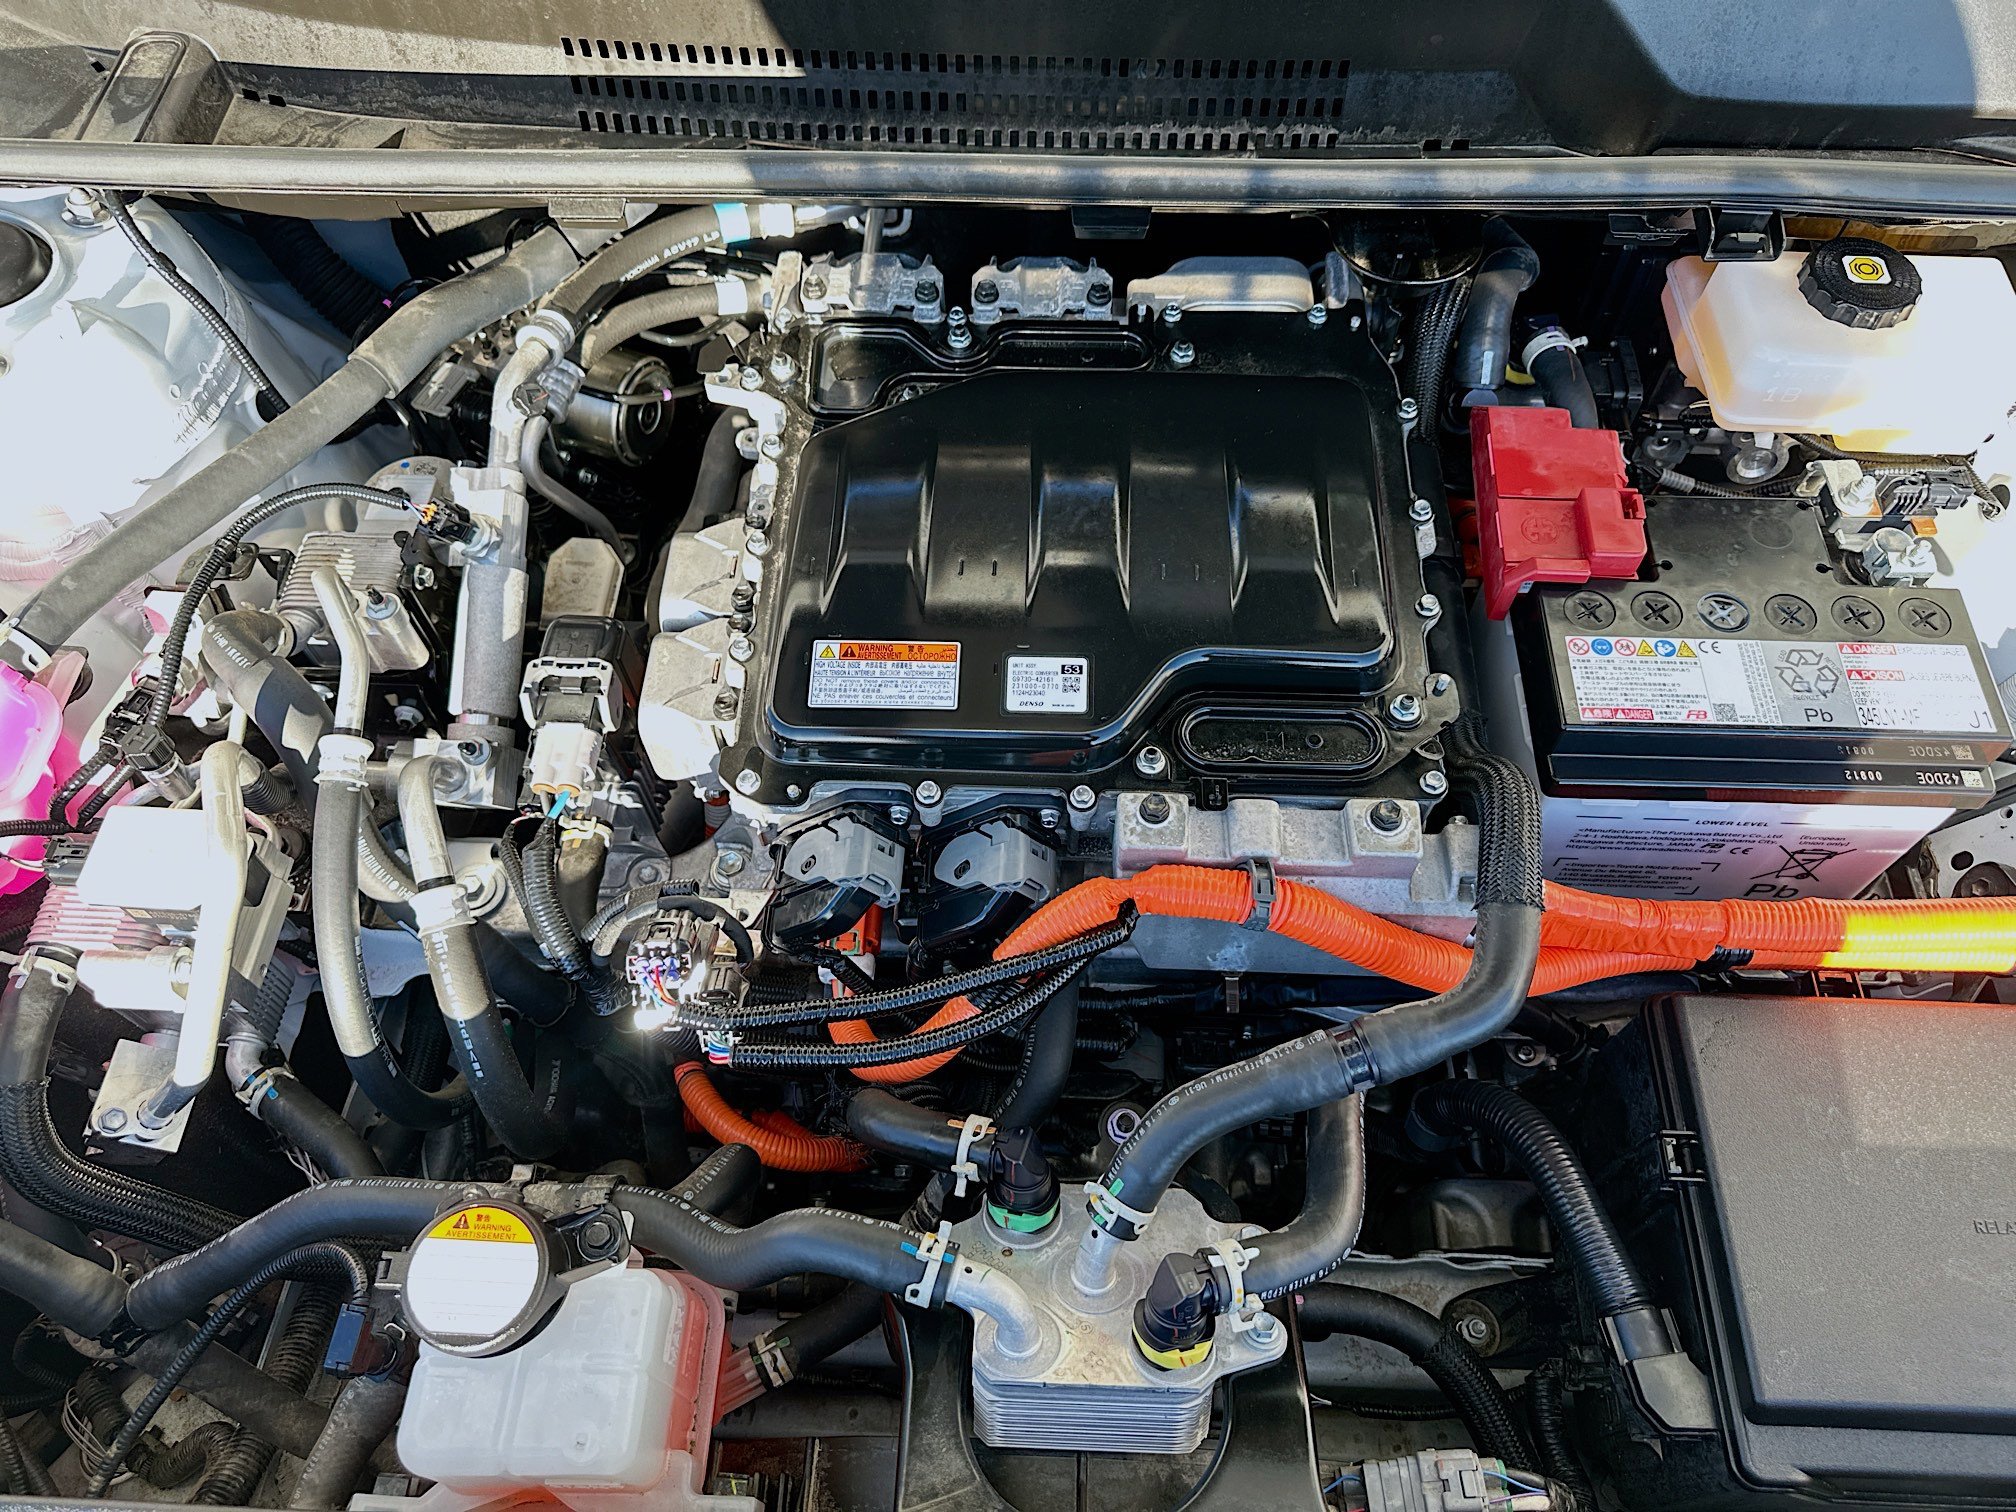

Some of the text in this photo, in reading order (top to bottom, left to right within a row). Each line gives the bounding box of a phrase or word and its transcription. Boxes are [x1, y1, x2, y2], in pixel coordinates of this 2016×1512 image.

[858, 644, 893, 652] WARNING
[1853, 645, 1895, 655] DANGER
[857, 651, 902, 660] AVERTISSEMENT
[1064, 665, 1080, 674] 53
[1861, 671, 1904, 680] POISON
[1625, 709, 1653, 719] DANGER
[1804, 708, 1833, 723] Pb
[1744, 883, 1799, 898] Pb
[1245, 1056, 1271, 1072] WATER
[1123, 1127, 1146, 1154] WATER
[708, 1156, 729, 1177] WATER
[473, 1223, 512, 1232] WARNING
[1973, 1219, 2016, 1235] RELA
[445, 1230, 517, 1240] AVERTISSEMENT
[1289, 1273, 1316, 1292] WATER
[1261, 1286, 1287, 1300] >EPDM
